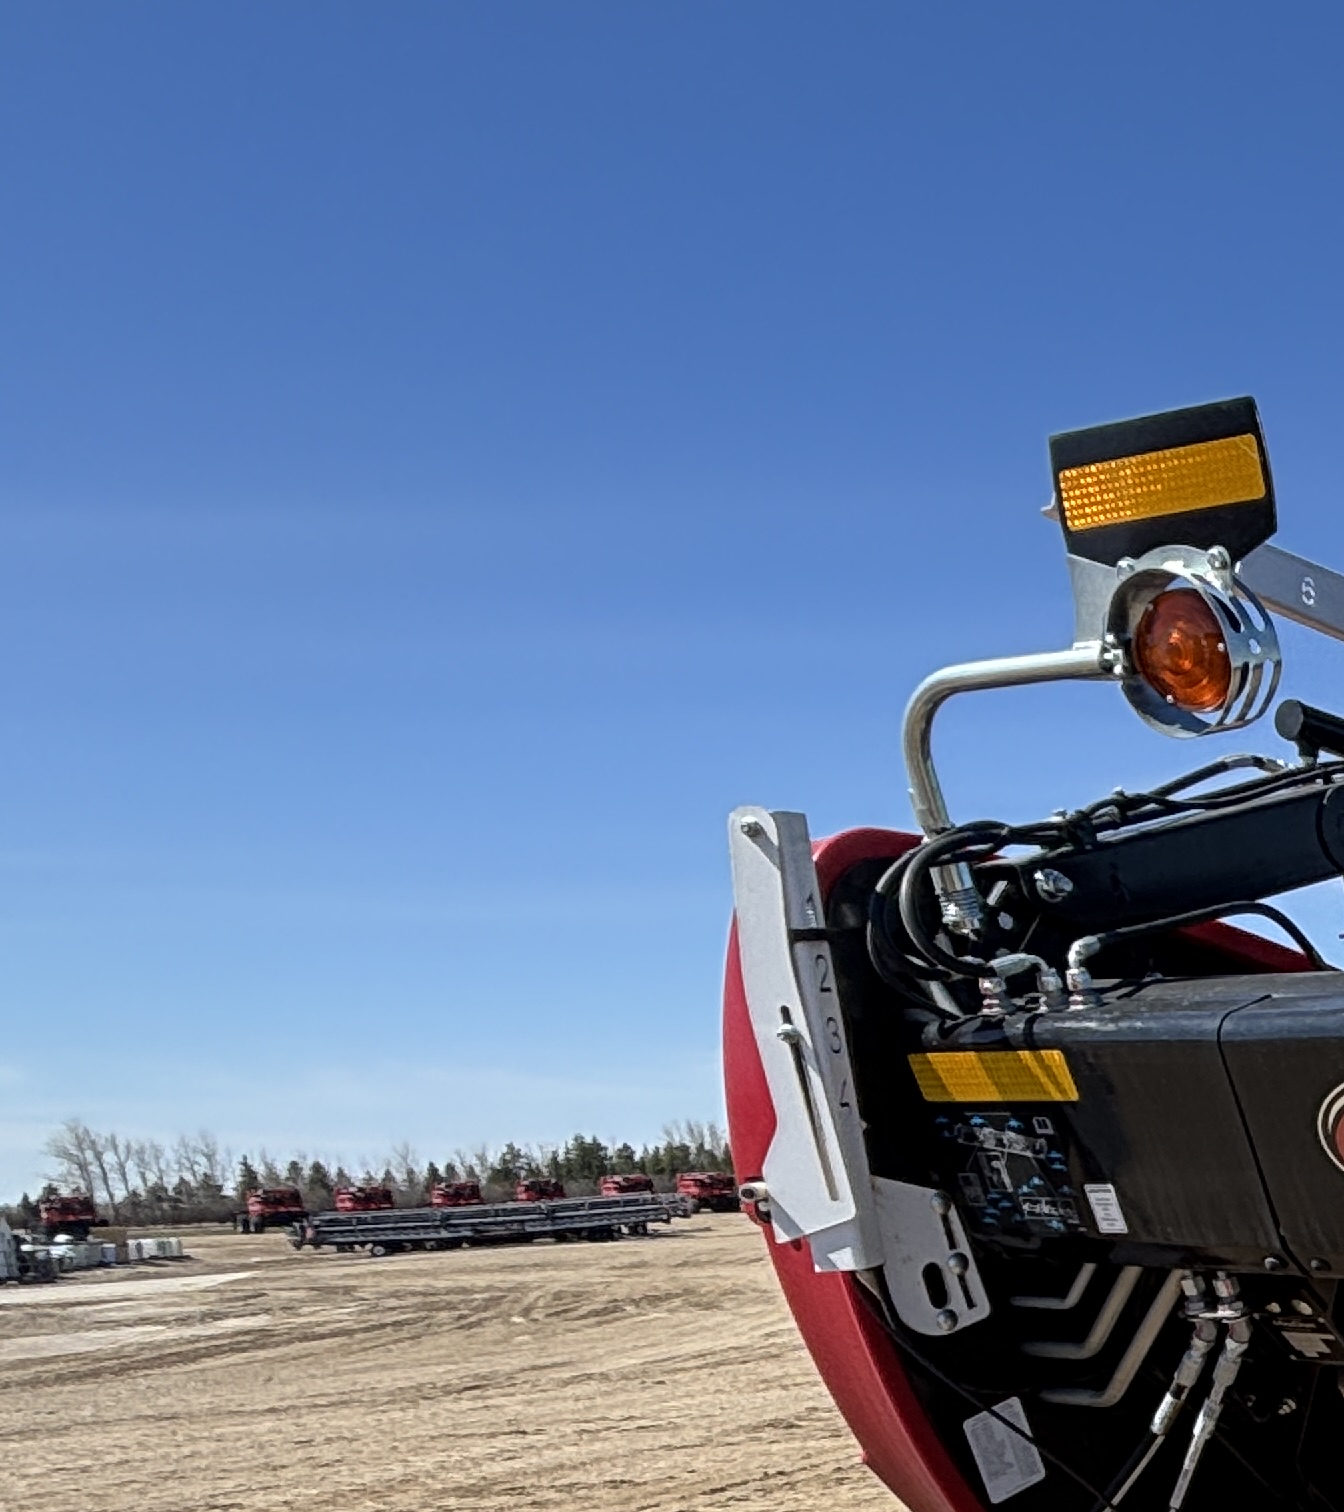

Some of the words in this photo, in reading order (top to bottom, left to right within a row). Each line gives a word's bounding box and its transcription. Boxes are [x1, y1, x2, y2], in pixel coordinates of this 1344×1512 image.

[1301, 576, 1316, 607] 6
[815, 954, 832, 993] 2
[826, 1016, 842, 1054] 3
